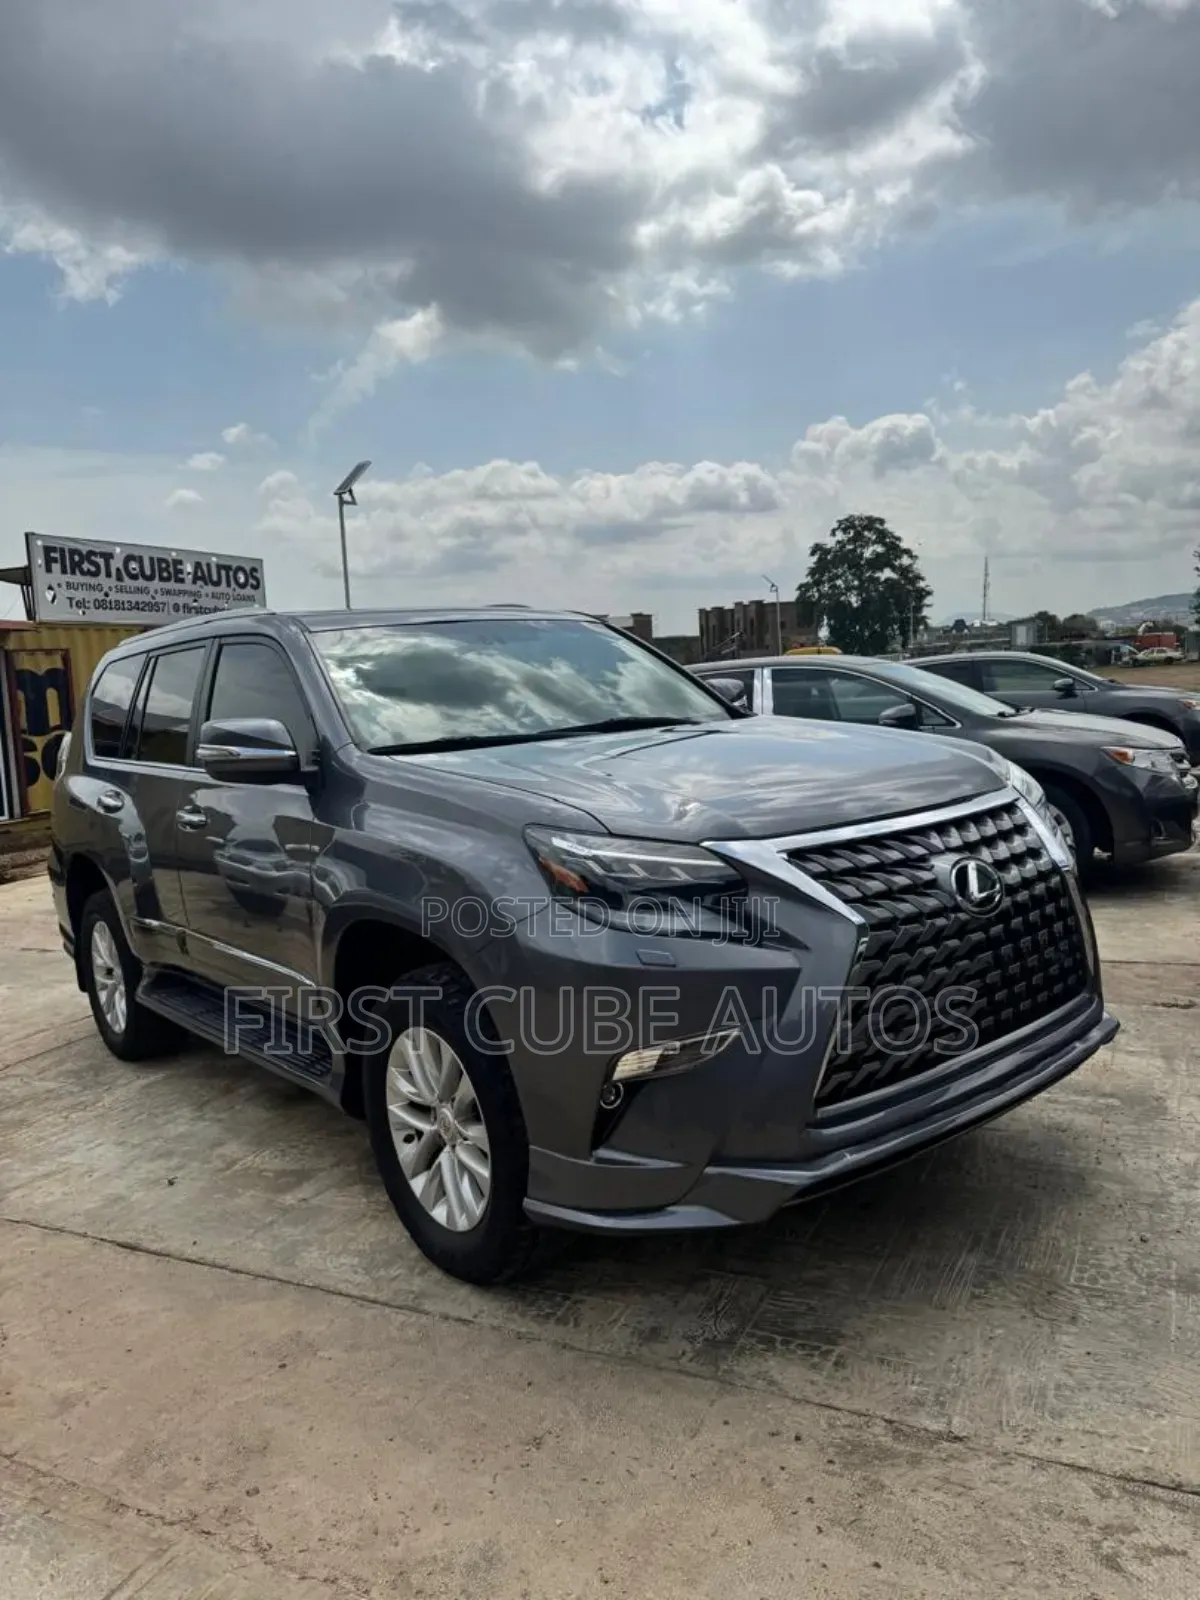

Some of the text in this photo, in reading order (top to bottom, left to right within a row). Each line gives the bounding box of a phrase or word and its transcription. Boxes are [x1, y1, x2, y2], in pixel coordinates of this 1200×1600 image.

[43, 545, 261, 590] FIRST CUBE AUTOS
[65, 581, 104, 592] BUYING
[114, 585, 151, 595] SELLING
[160, 587, 202, 599] SWAPPING
[211, 591, 231, 601] AUTO
[66, 596, 91, 609] Tel:
